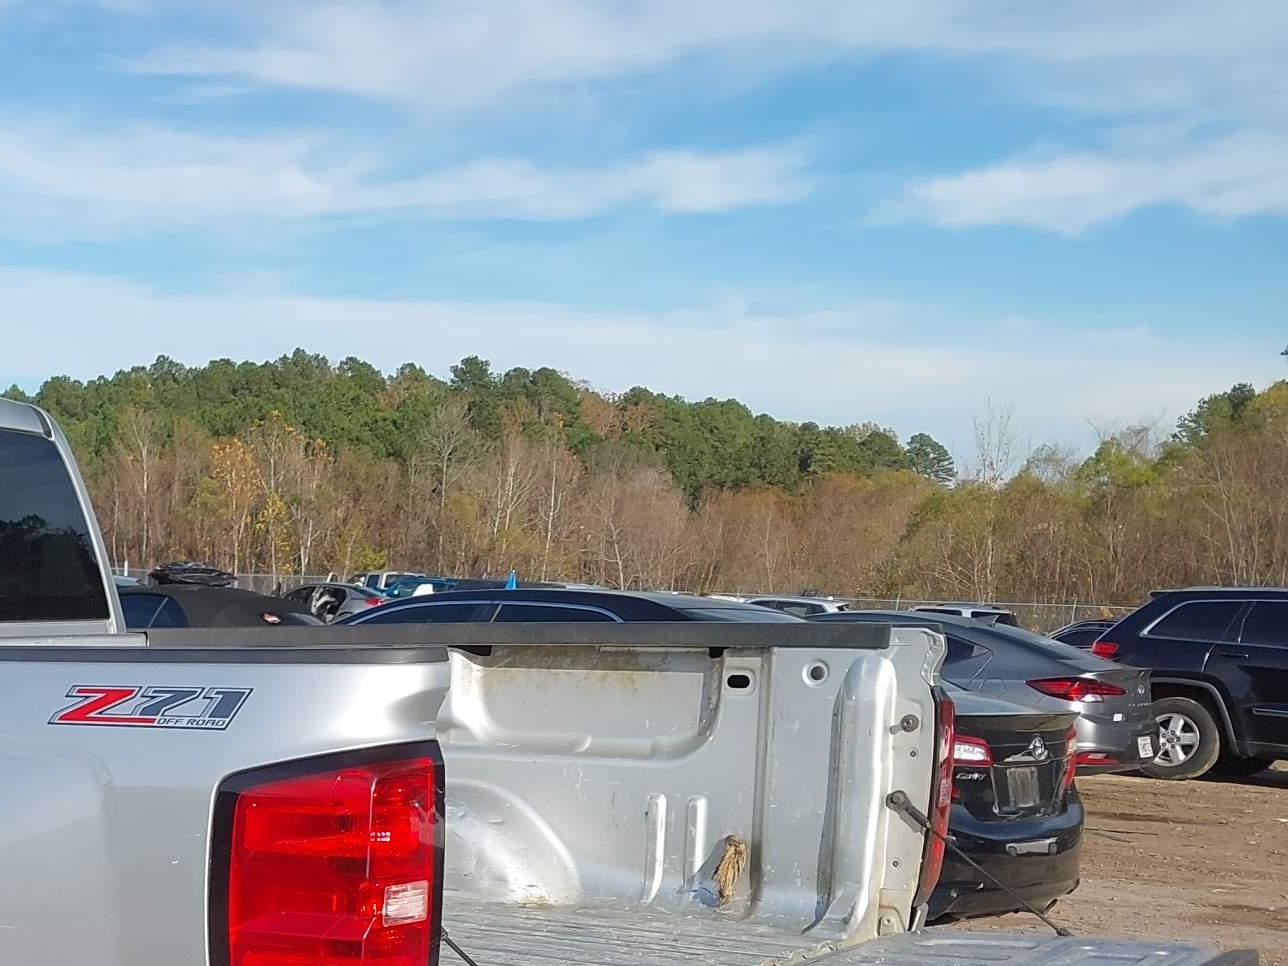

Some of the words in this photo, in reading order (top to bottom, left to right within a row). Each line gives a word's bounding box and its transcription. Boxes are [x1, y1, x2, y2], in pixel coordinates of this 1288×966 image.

[48, 685, 253, 729] Z71
[157, 718, 185, 726] OFF
[186, 718, 227, 727] ROAD
